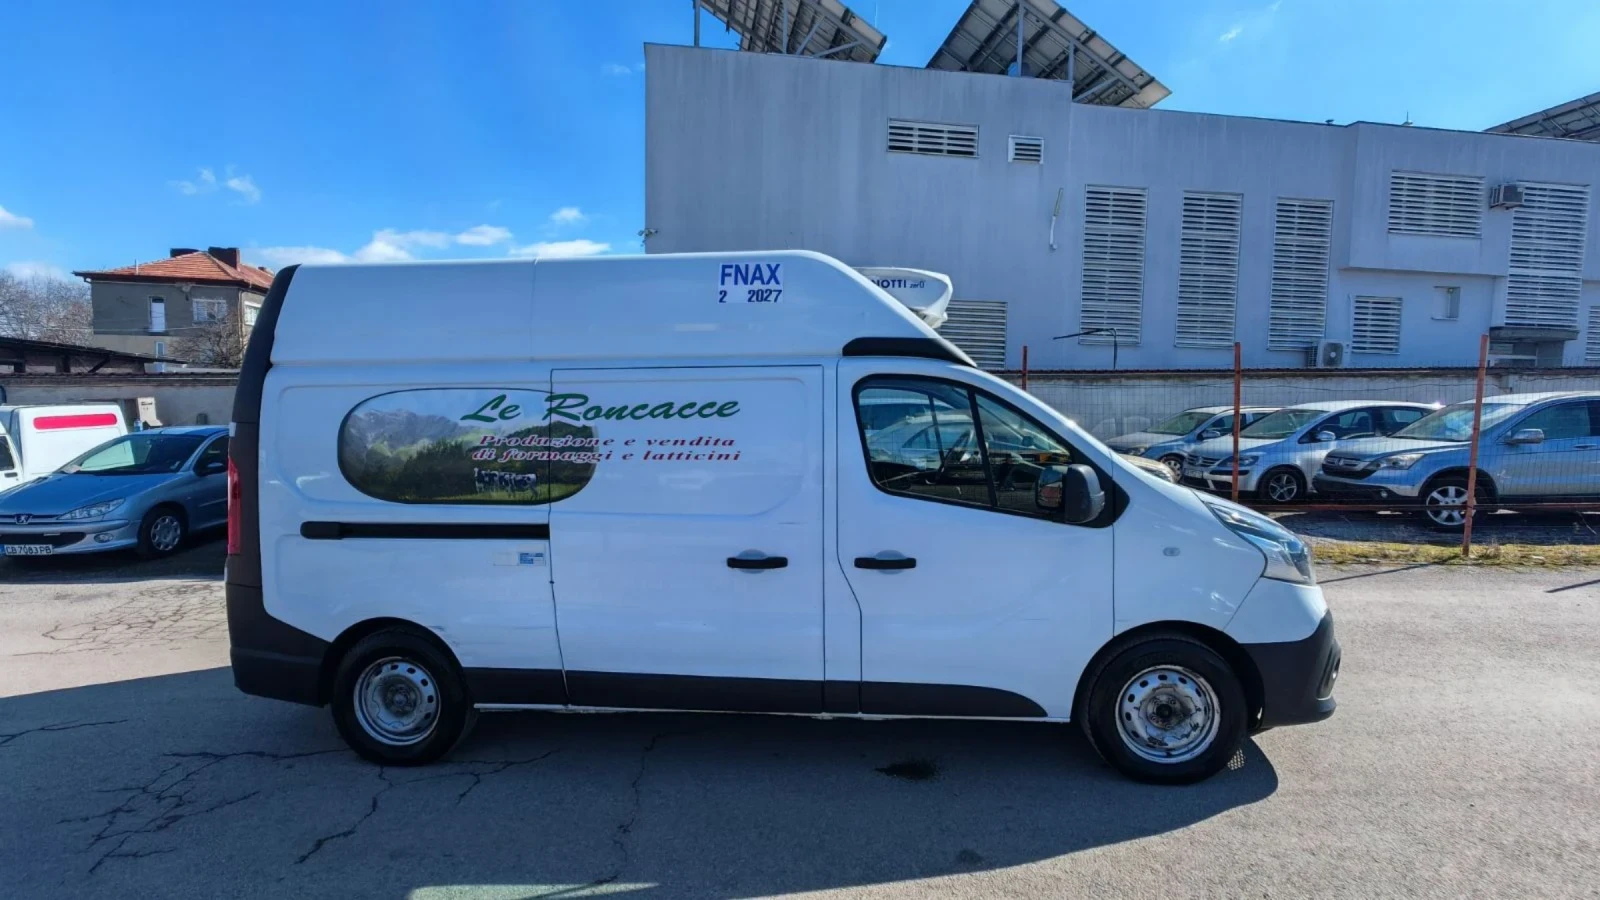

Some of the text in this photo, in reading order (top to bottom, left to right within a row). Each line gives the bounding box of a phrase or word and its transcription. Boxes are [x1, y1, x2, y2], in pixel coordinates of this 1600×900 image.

[720, 264, 781, 286] FNAX
[719, 289, 782, 303] 2 2027
[460, 393, 740, 423] Le Roncacce
[479, 434, 735, 447] Produzione e vendita
[472, 449, 741, 463] di formaggi e latticini
